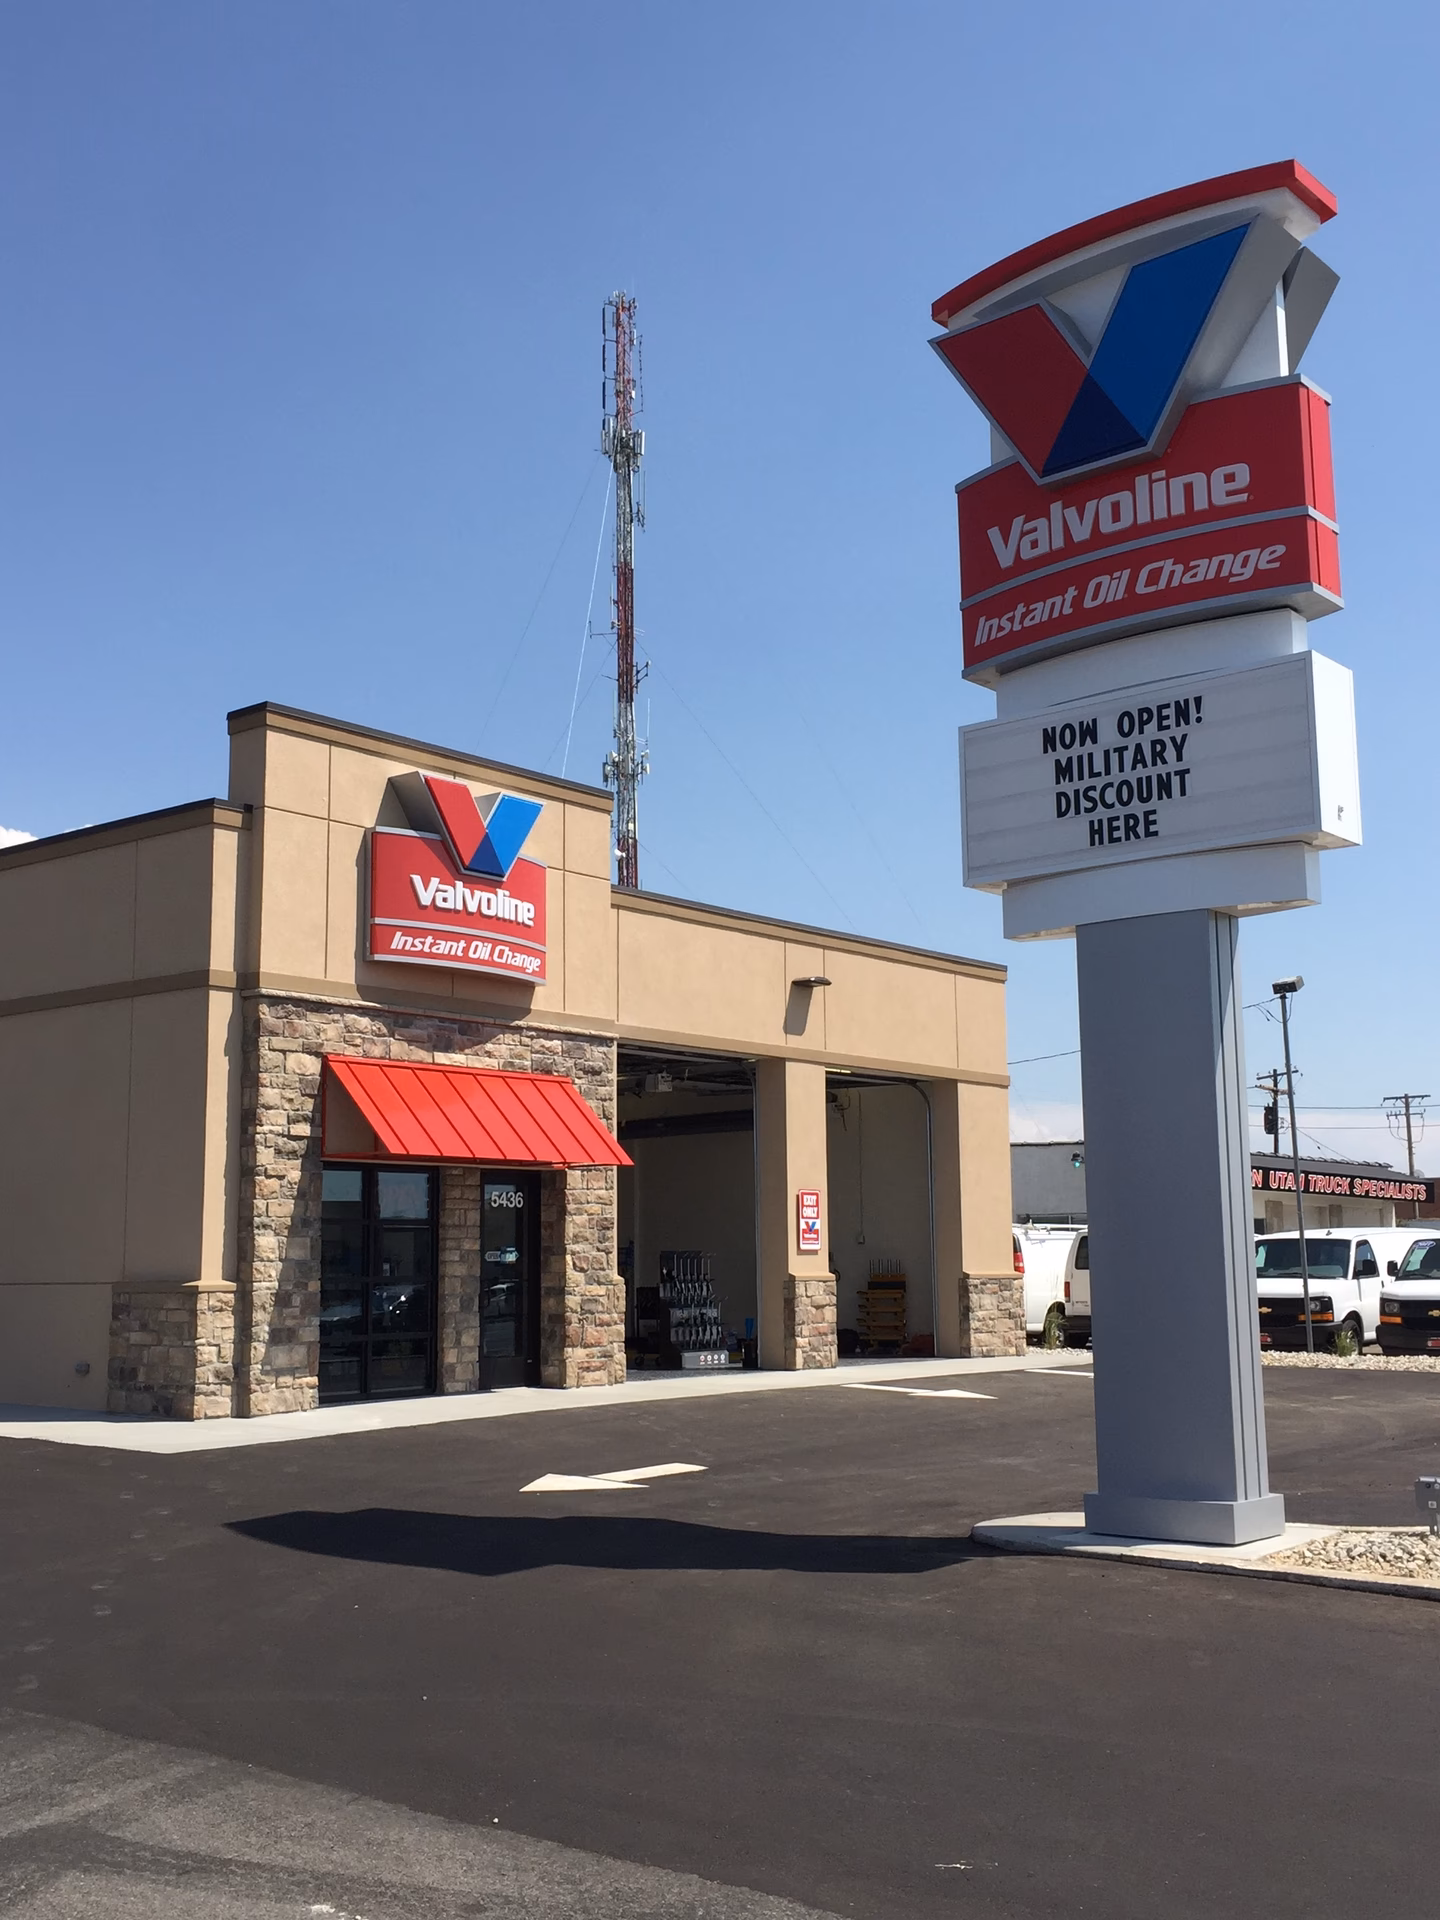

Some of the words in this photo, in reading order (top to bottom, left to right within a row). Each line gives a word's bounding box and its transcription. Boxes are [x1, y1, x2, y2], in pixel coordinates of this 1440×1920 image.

[987, 463, 1250, 569] Valvoline
[975, 585, 1078, 647] Instant
[1083, 569, 1131, 608] Oil
[1135, 544, 1287, 595] Change
[1042, 717, 1099, 755] NOW
[1116, 695, 1204, 739] OPEN!
[1054, 733, 1189, 786] MILITARY
[1055, 768, 1190, 819] DISCOUNT
[1089, 809, 1159, 847] HERE
[409, 873, 535, 927] Valvoline
[390, 931, 466, 957] Instant
[468, 940, 492, 961] Oil
[493, 945, 542, 973] Change
[491, 1190, 524, 1208] 5436
[1308, 1174, 1351, 1195] TRUCK
[1353, 1177, 1427, 1201] SPECIALISTS
